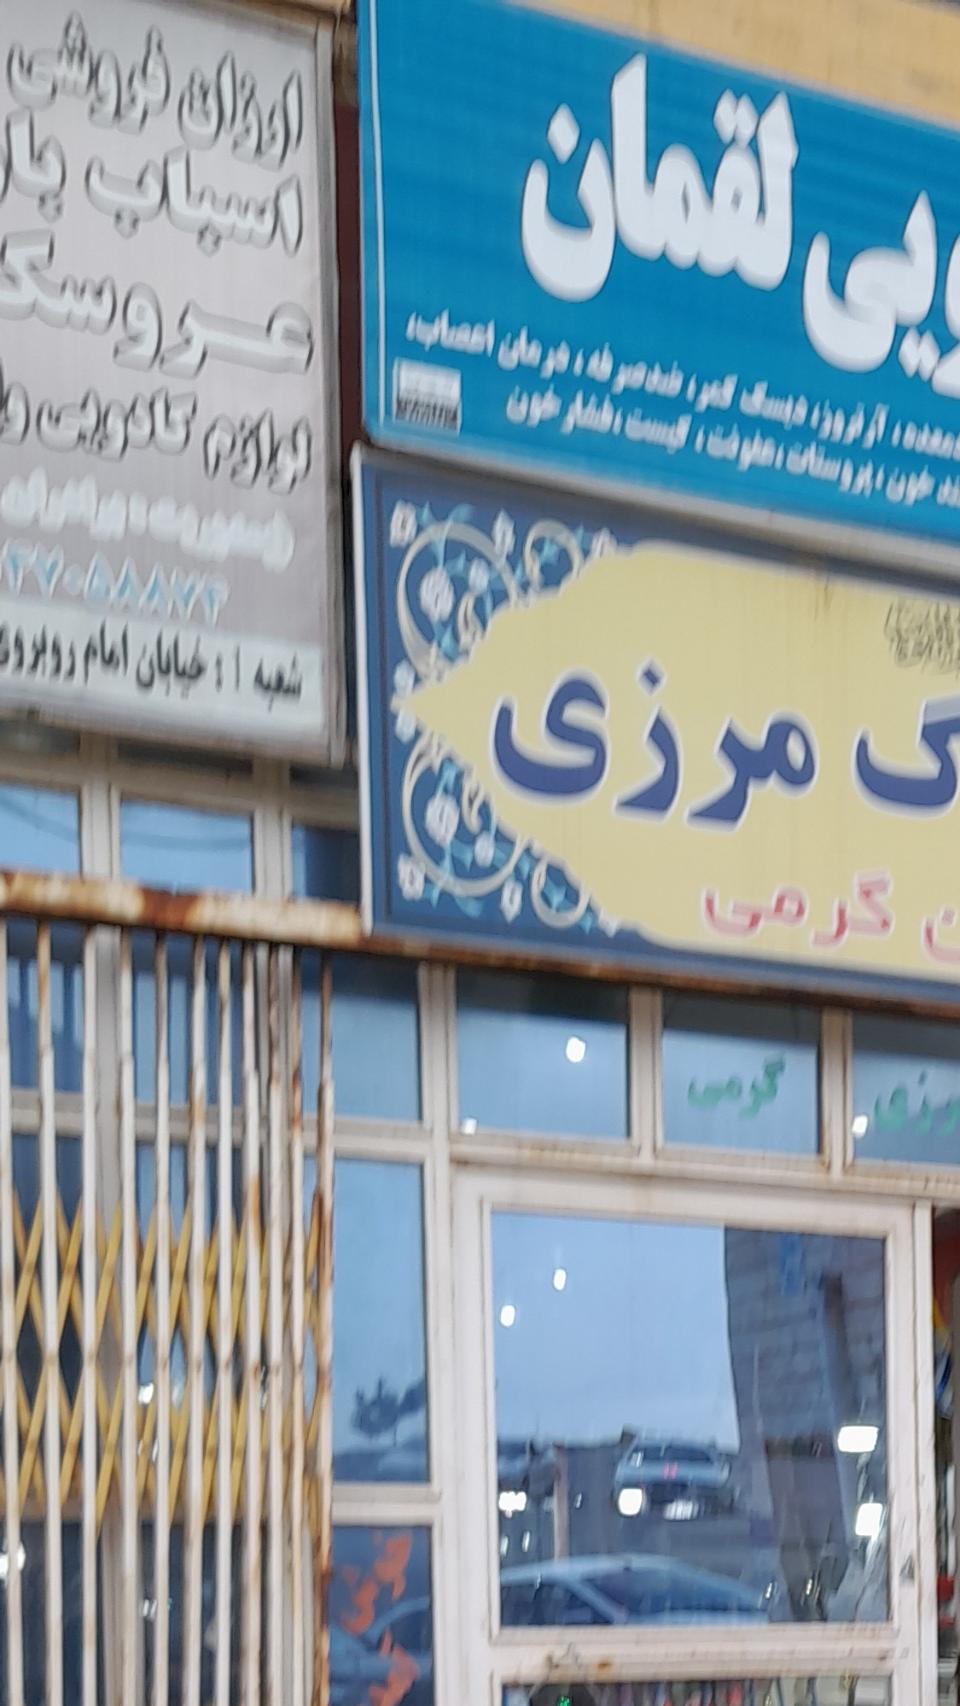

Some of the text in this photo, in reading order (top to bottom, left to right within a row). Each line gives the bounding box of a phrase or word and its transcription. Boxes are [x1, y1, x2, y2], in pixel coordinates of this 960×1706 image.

[6, 10, 303, 172] ارزان فروشی
[85, 146, 303, 258] اسباب
[521, 52, 798, 302] لقمان
[491, 660, 818, 831] مرزی
[703, 868, 894, 947] گرمی
